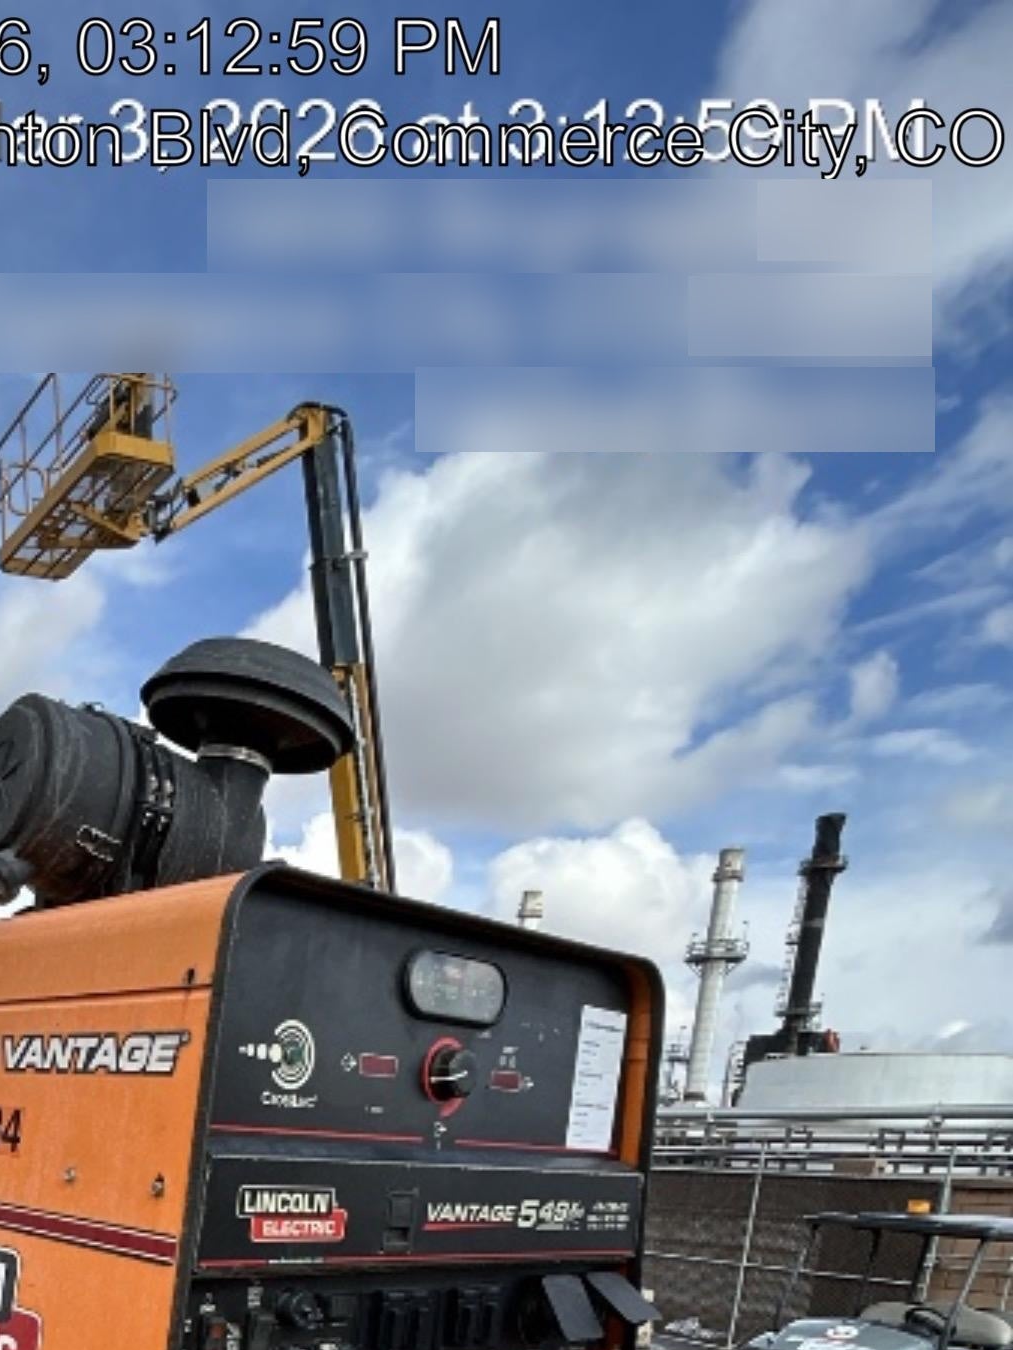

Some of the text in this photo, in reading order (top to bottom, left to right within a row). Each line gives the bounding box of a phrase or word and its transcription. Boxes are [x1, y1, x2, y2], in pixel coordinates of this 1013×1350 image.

[2, 1033, 182, 1076] VANTAGE
[243, 1191, 332, 1215] LINCOLN
[426, 1202, 518, 1223] VANTAGE
[261, 1219, 337, 1238] ELECTRIC
